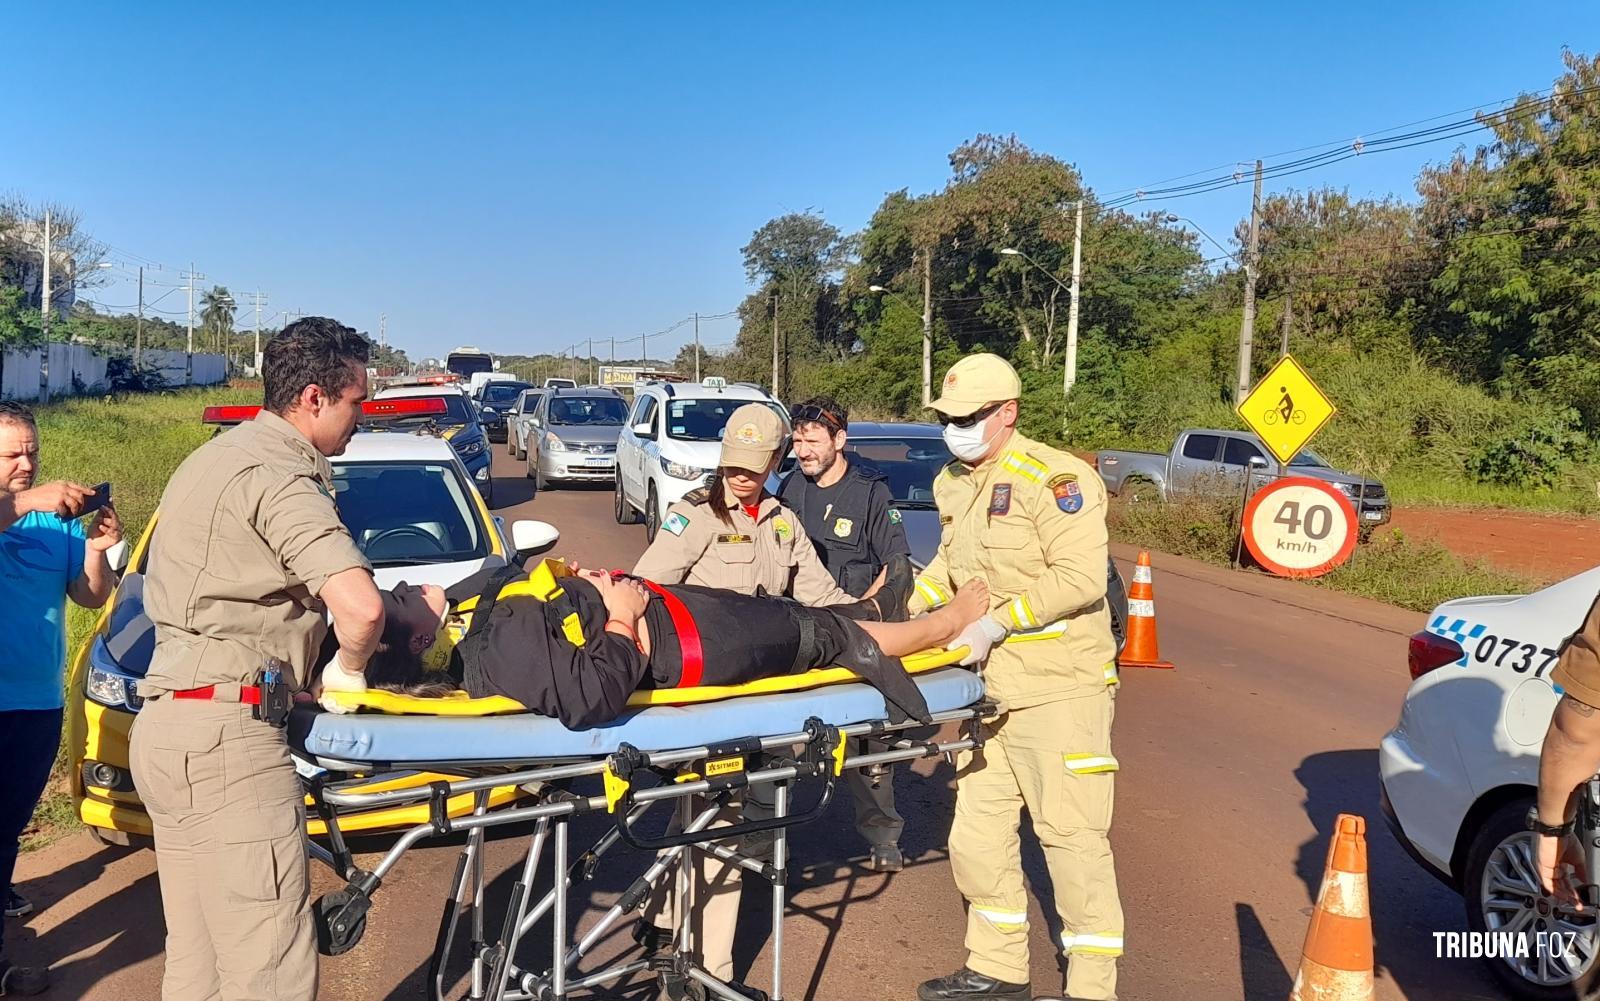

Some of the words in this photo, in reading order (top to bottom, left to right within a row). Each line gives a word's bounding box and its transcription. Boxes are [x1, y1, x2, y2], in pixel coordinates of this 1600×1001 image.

[706, 378, 724, 386] TAXI
[1273, 501, 1333, 540] 40
[1276, 538, 1318, 554] km/h
[1474, 634, 1558, 678] 0737
[717, 761, 739, 769] SITMED
